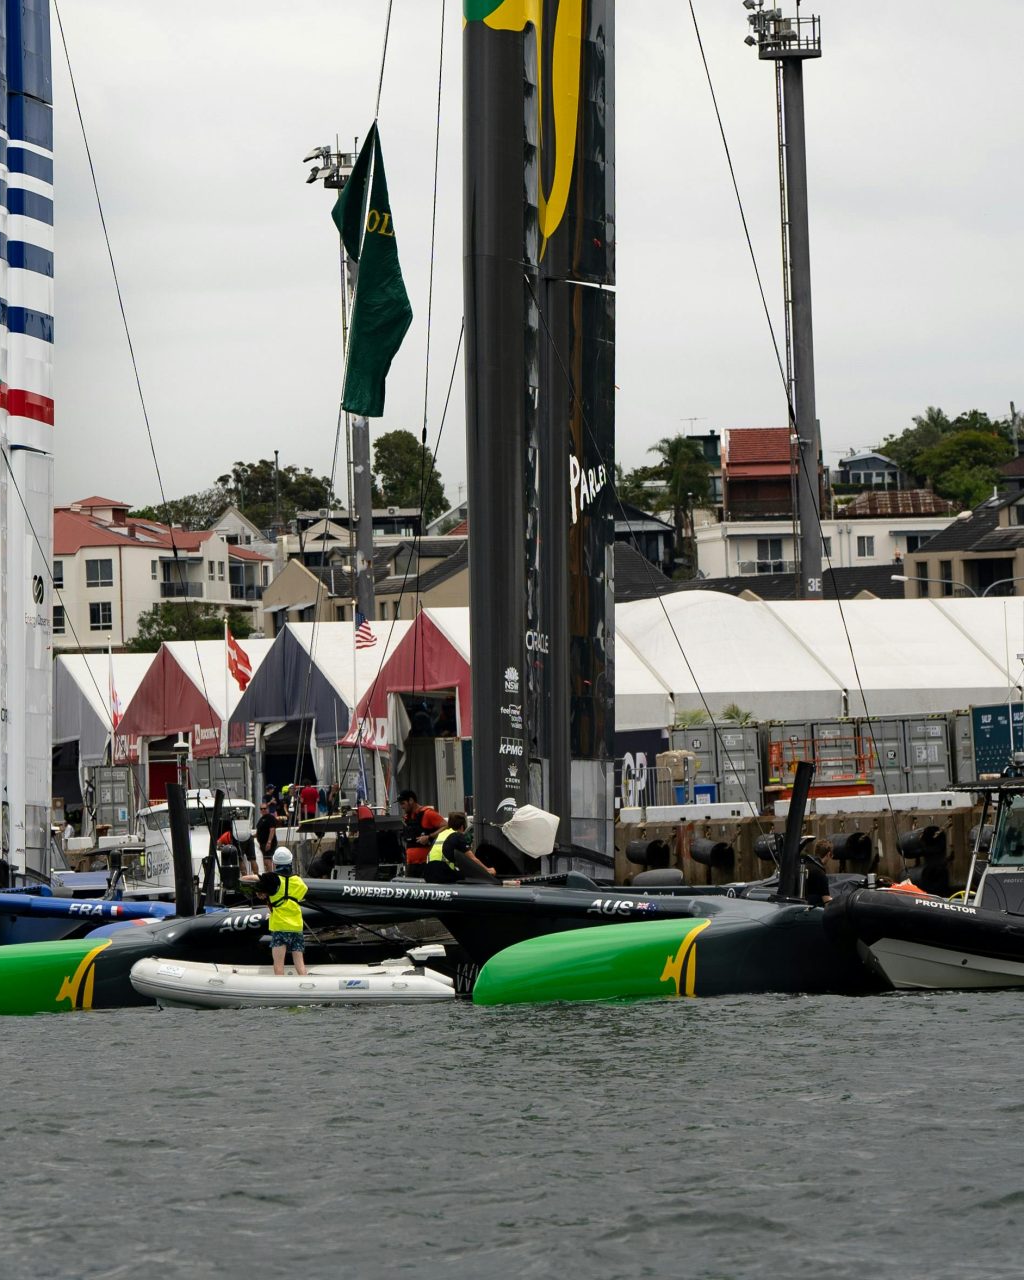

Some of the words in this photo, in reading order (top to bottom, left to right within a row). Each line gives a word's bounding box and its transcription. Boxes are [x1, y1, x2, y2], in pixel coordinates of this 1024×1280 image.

[569, 453, 608, 524] PARLEY
[499, 743, 524, 756] KPMG
[342, 885, 394, 898] POWERED
[394, 888, 409, 899] BY
[68, 903, 104, 917] FRA
[587, 899, 634, 916] AUS
[915, 898, 977, 915] PROTECTOR
[219, 913, 263, 933] AUS
